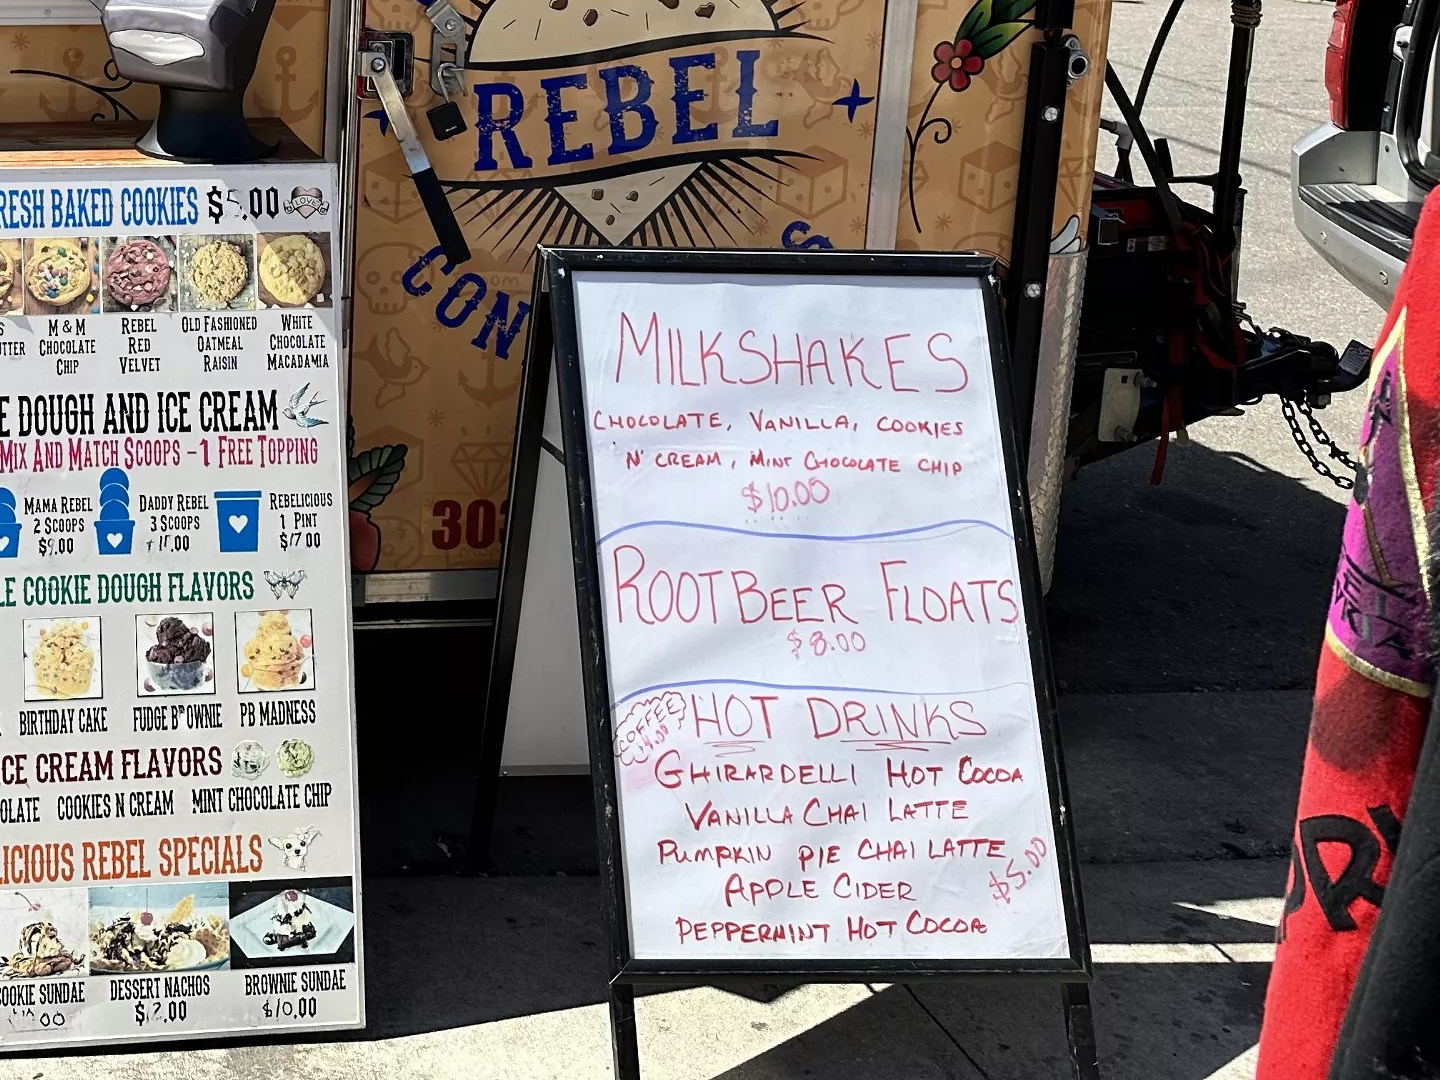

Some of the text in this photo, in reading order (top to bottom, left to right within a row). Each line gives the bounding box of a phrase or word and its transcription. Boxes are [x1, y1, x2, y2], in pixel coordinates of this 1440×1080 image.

[472, 49, 780, 172] REBEL
[52, 187, 113, 227] BAKED
[121, 186, 199, 226] COOKIES
[121, 318, 157, 334] REBEL
[182, 316, 257, 333] OLD FASHIONED
[281, 314, 313, 330] WHITE
[39, 340, 96, 356] CHOCOLATE
[128, 338, 151, 354] RED
[197, 336, 243, 353] OATMEAL
[270, 333, 325, 351] CHOCOLATE
[616, 311, 968, 393] MILKSHAKES
[56, 359, 80, 376] CHIP
[120, 357, 160, 374] VELVET
[203, 355, 238, 372] RAISIN
[267, 353, 329, 370] MACADAMIA
[17, 393, 95, 436] DOUGH
[104, 392, 150, 434] AND
[158, 391, 191, 433] ICE
[199, 389, 279, 432] CREAM
[593, 409, 963, 437] CHOCOLATE, VANILLA, COOKIES
[0, 440, 27, 473] MIX
[33, 439, 63, 472] AND
[68, 438, 119, 471] MATCH
[124, 437, 181, 470] SCOOPS
[218, 435, 253, 467] FREE
[258, 434, 318, 465] TOPPING
[749, 451, 963, 477] MINT CHOCOLATE CHIP
[24, 497, 93, 514] MAMA REBEL
[139, 494, 209, 511] DADDY REBEL
[270, 493, 333, 508] REBELICIOUS
[741, 477, 830, 515] $10.00
[44, 517, 85, 533] SCOOPS
[160, 514, 200, 531] SCOOPS
[294, 513, 318, 529] PINT
[23, 575, 91, 606] COOKIE
[98, 574, 161, 604] DOUGH
[168, 571, 255, 602] FLAVORS
[880, 560, 1019, 625] FLOATS
[787, 631, 867, 660] $8.00
[19, 707, 108, 736] BIRTHDAY CAKE
[133, 706, 171, 732] FUDGE
[240, 700, 316, 727] PB MADNESS
[619, 698, 681, 752] COFFEE
[694, 692, 987, 741] HOT DRINKS
[36, 751, 113, 783] CREAM
[121, 748, 222, 781] FLAVORS
[654, 750, 1024, 789] GHIRARDELLI HOT COCOA
[58, 790, 174, 821] COOKIES N CREAM
[192, 783, 332, 814] MINT CHOCOLATE CHIP
[685, 798, 968, 831] VANILLA CHAI LATTE
[82, 839, 151, 881] REBEL
[160, 835, 263, 877] SPECIALS
[657, 838, 1005, 872] PUMPKIN PIE CHAI LATTE
[989, 836, 1048, 904] $5.00
[725, 873, 917, 907] APPLE CIDER
[676, 910, 988, 945] PEPPERMINT HOT COCOA
[39, 982, 85, 1005] SUNDAE
[110, 975, 210, 1001] DESSERT NACHOS
[245, 969, 346, 996] BROWNIE SUNDAE
[263, 997, 316, 1019] $10.00
